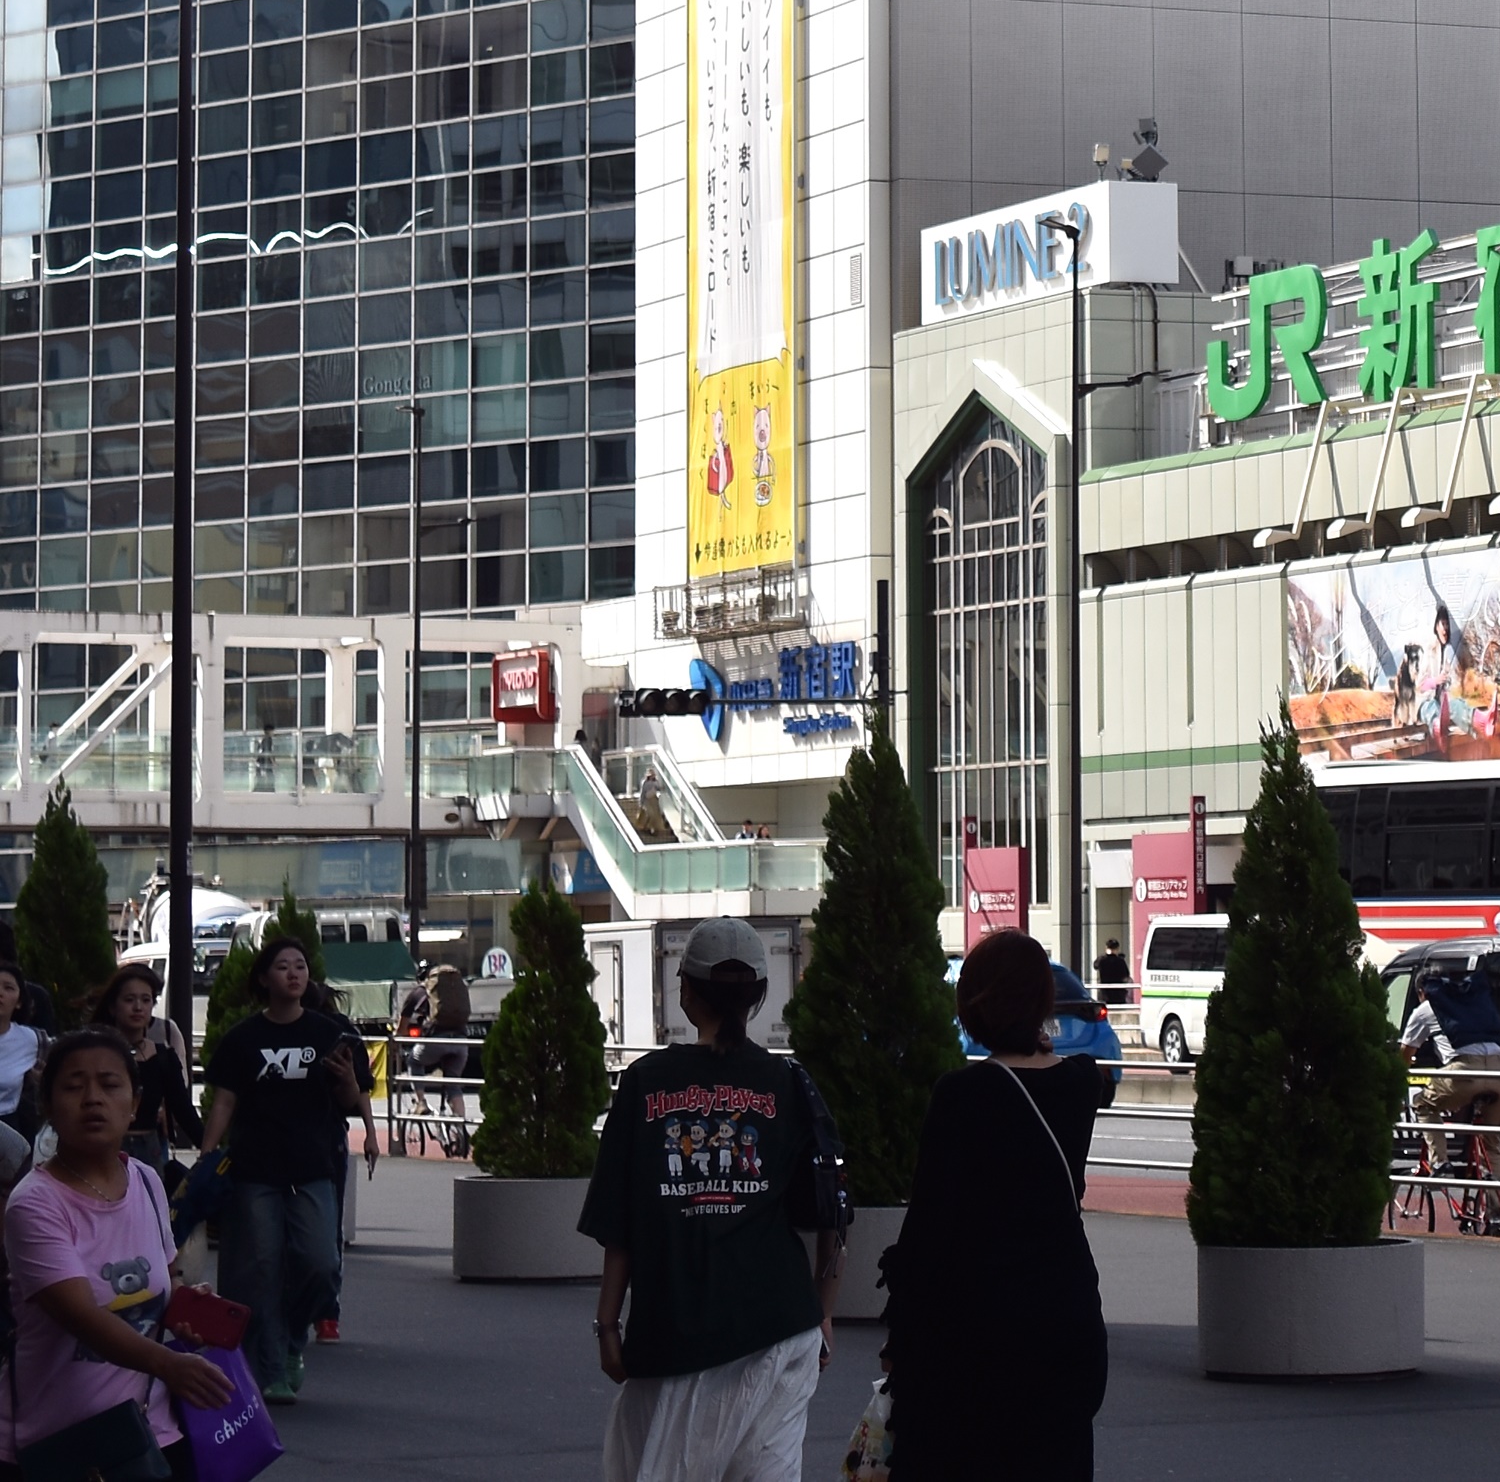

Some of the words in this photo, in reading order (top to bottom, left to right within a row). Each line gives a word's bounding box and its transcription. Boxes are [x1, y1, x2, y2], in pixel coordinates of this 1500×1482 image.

[934, 209, 1063, 306] LUMINE
[1065, 201, 1090, 274] 2
[779, 640, 857, 701] 新宿駅
[488, 954, 507, 974] BR
[645, 1085, 714, 1122] Hungry
[713, 1085, 776, 1119] Players
[660, 1179, 730, 1196] BASEBALL
[732, 1180, 769, 1193] KIDS
[705, 1204, 729, 1215] GIVES
[214, 1404, 254, 1445] GANSO
